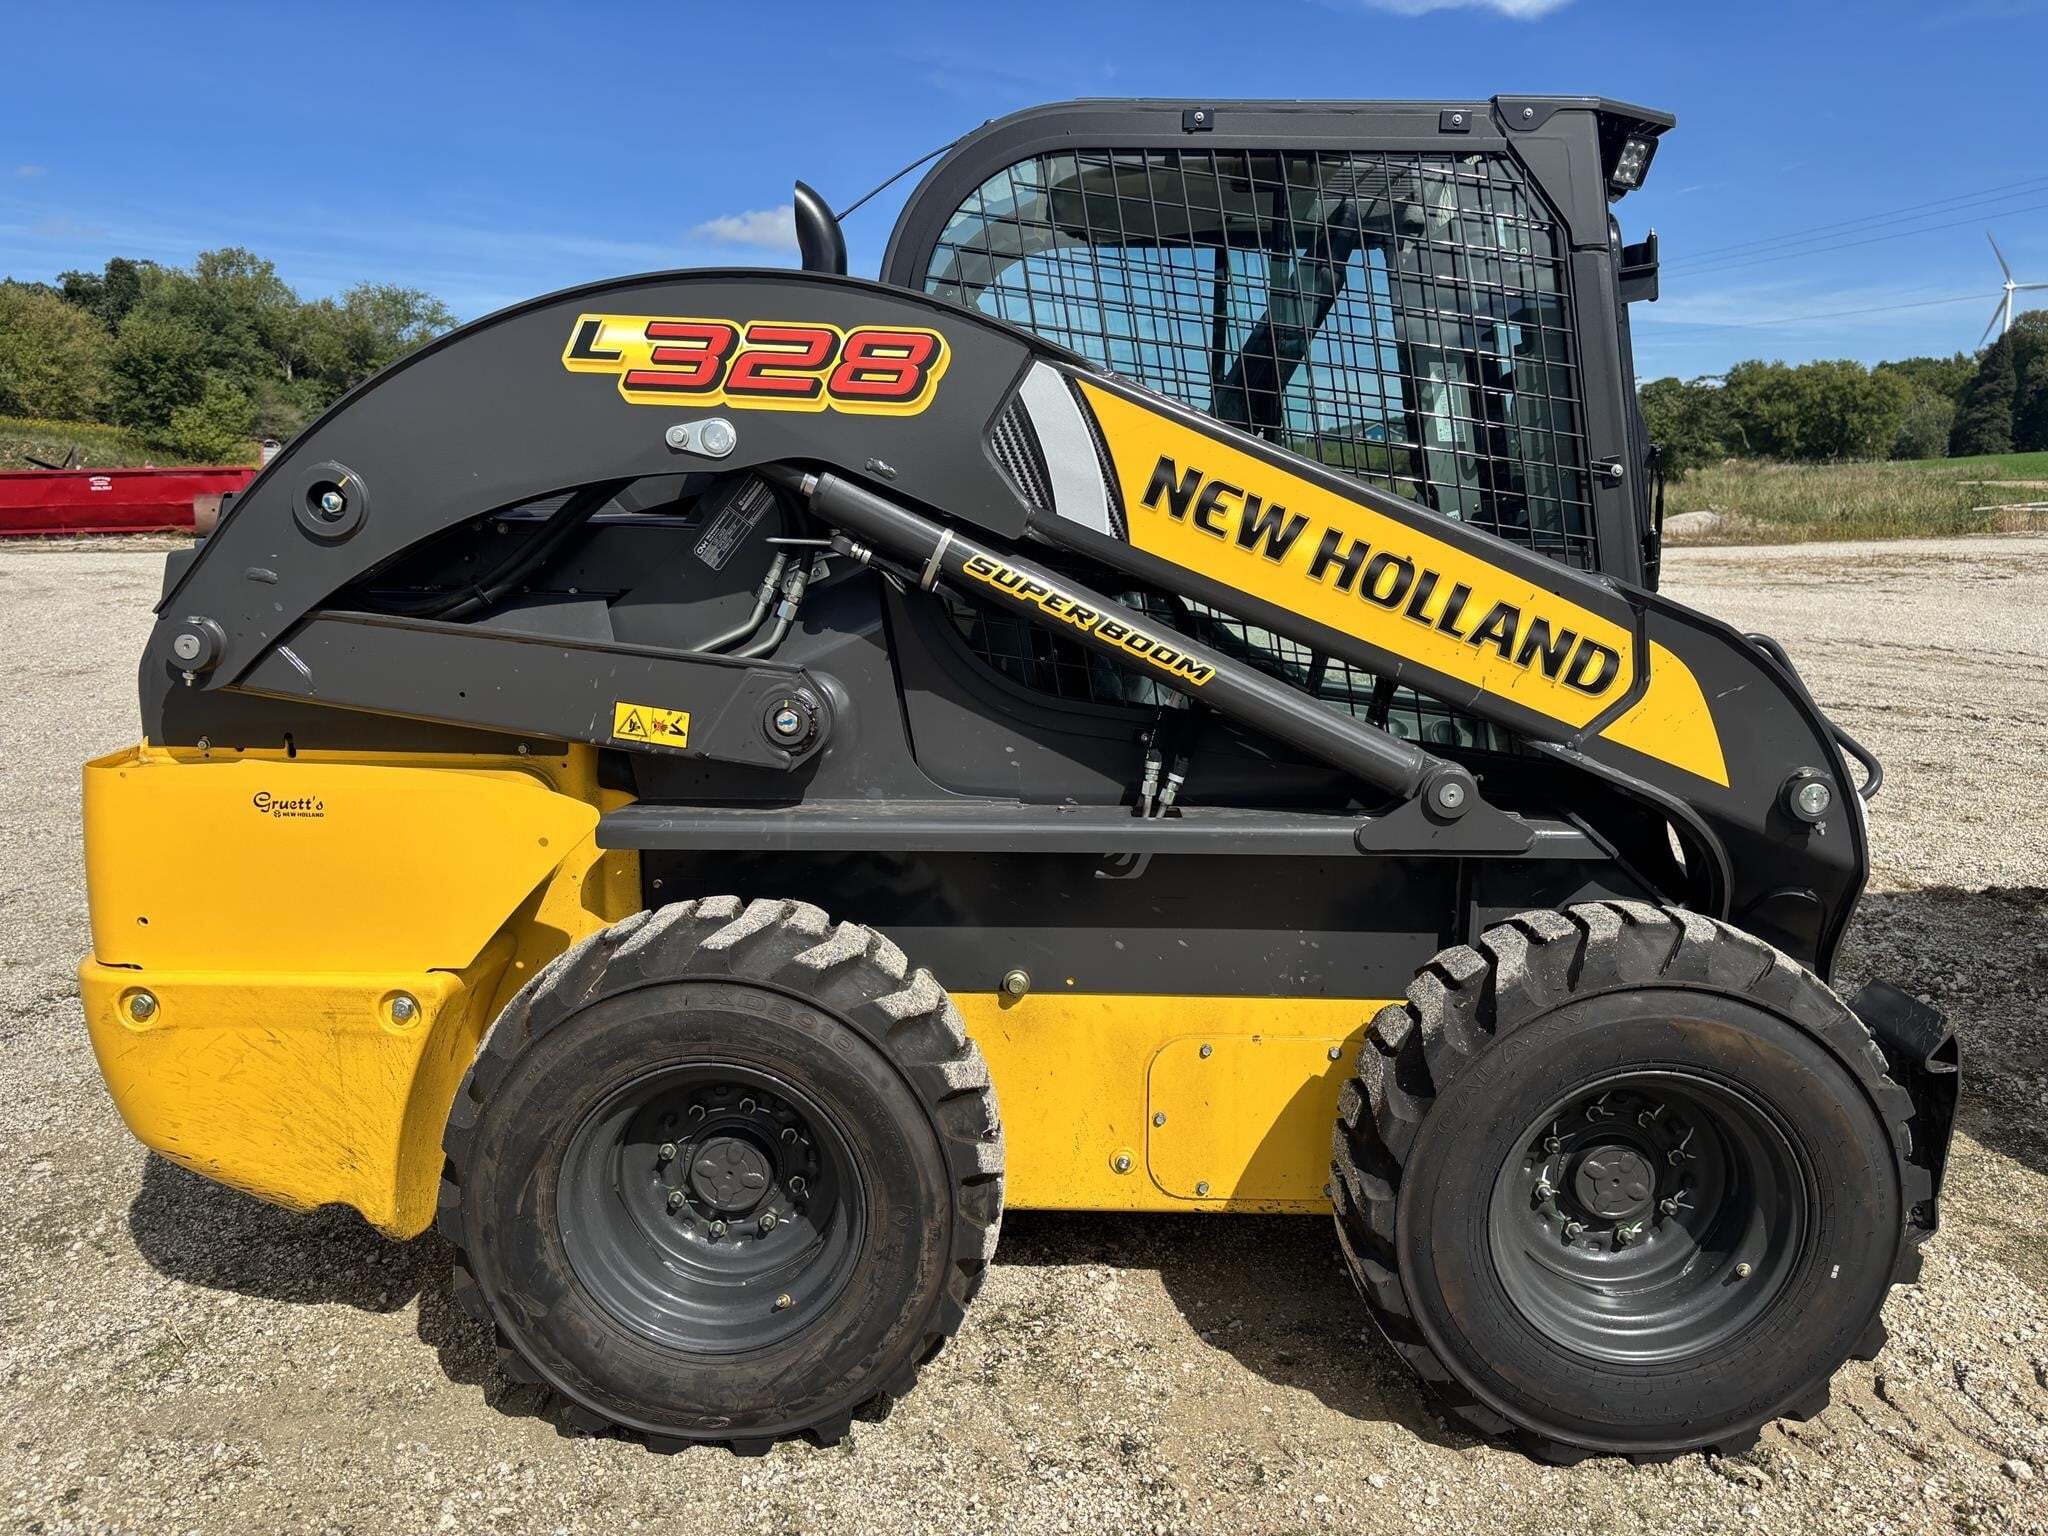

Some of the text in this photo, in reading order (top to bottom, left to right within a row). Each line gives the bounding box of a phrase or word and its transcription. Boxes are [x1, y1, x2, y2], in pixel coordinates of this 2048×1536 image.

[963, 553, 1216, 685] SUPER BOOM
[1140, 453, 1622, 697] NEW HOLLAND
[253, 792, 324, 813] Gruett's
[704, 989, 855, 1054] XD2010
